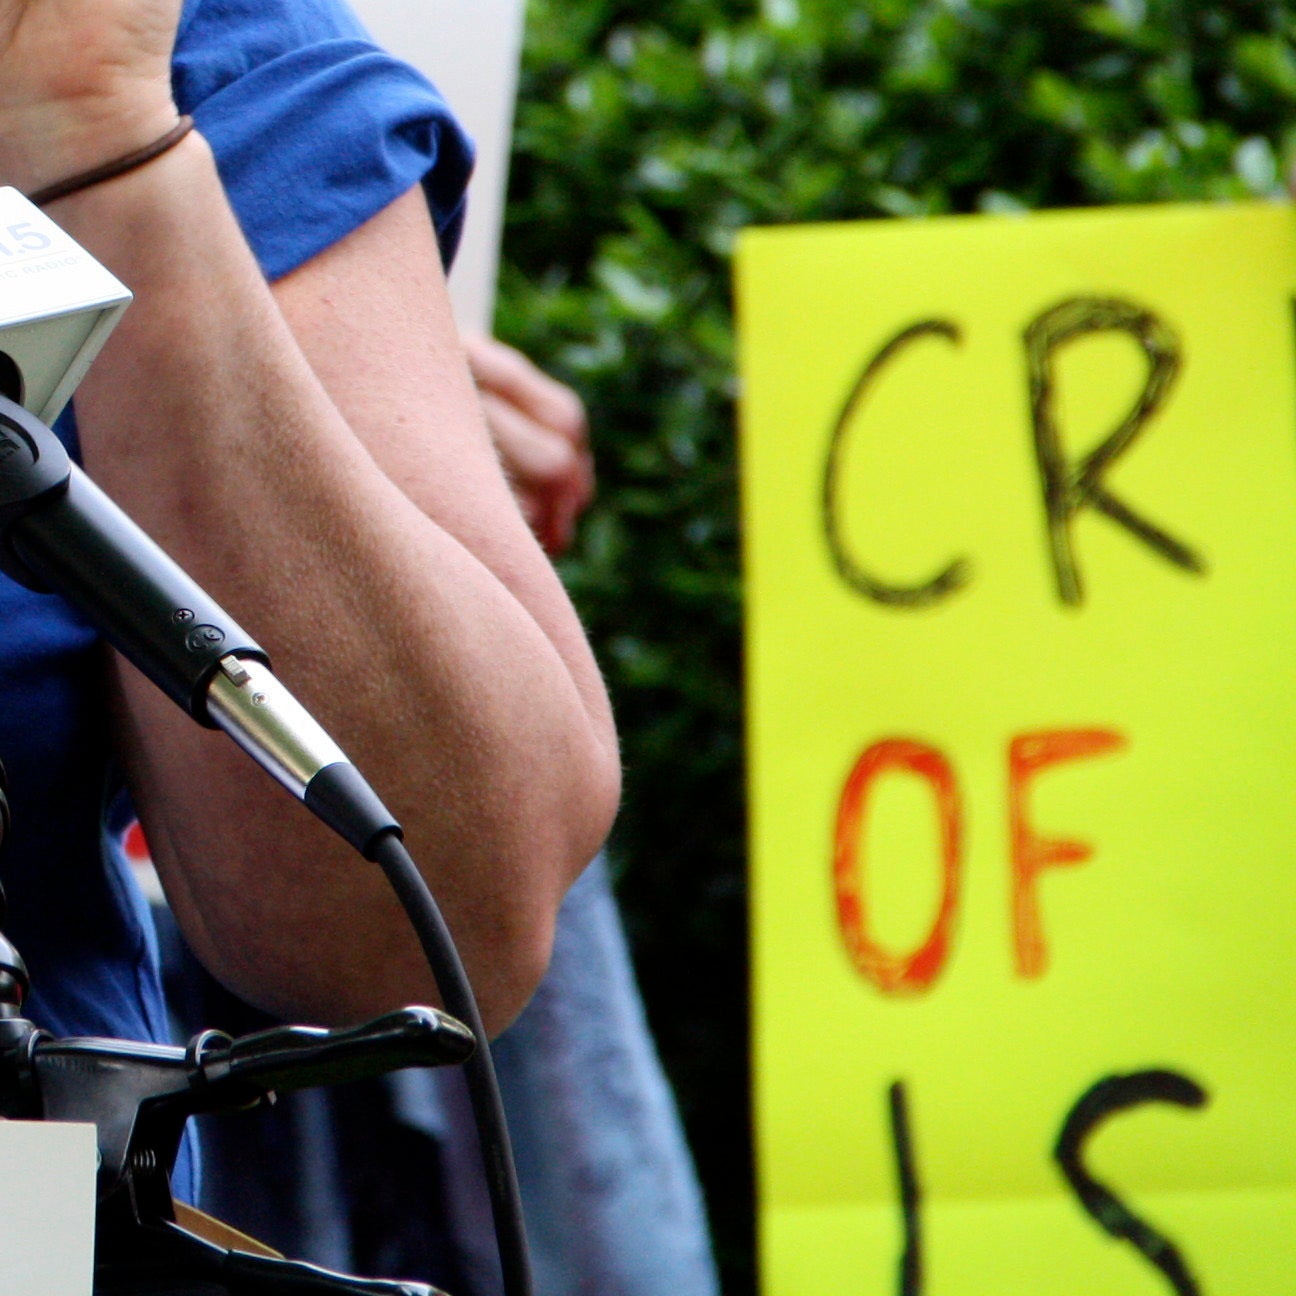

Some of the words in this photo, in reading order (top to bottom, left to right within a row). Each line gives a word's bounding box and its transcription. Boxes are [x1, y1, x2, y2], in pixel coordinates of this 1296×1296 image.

[21, 254, 77, 277] RADIO
[821, 291, 1296, 612] CR
[831, 725, 1128, 998] OF
